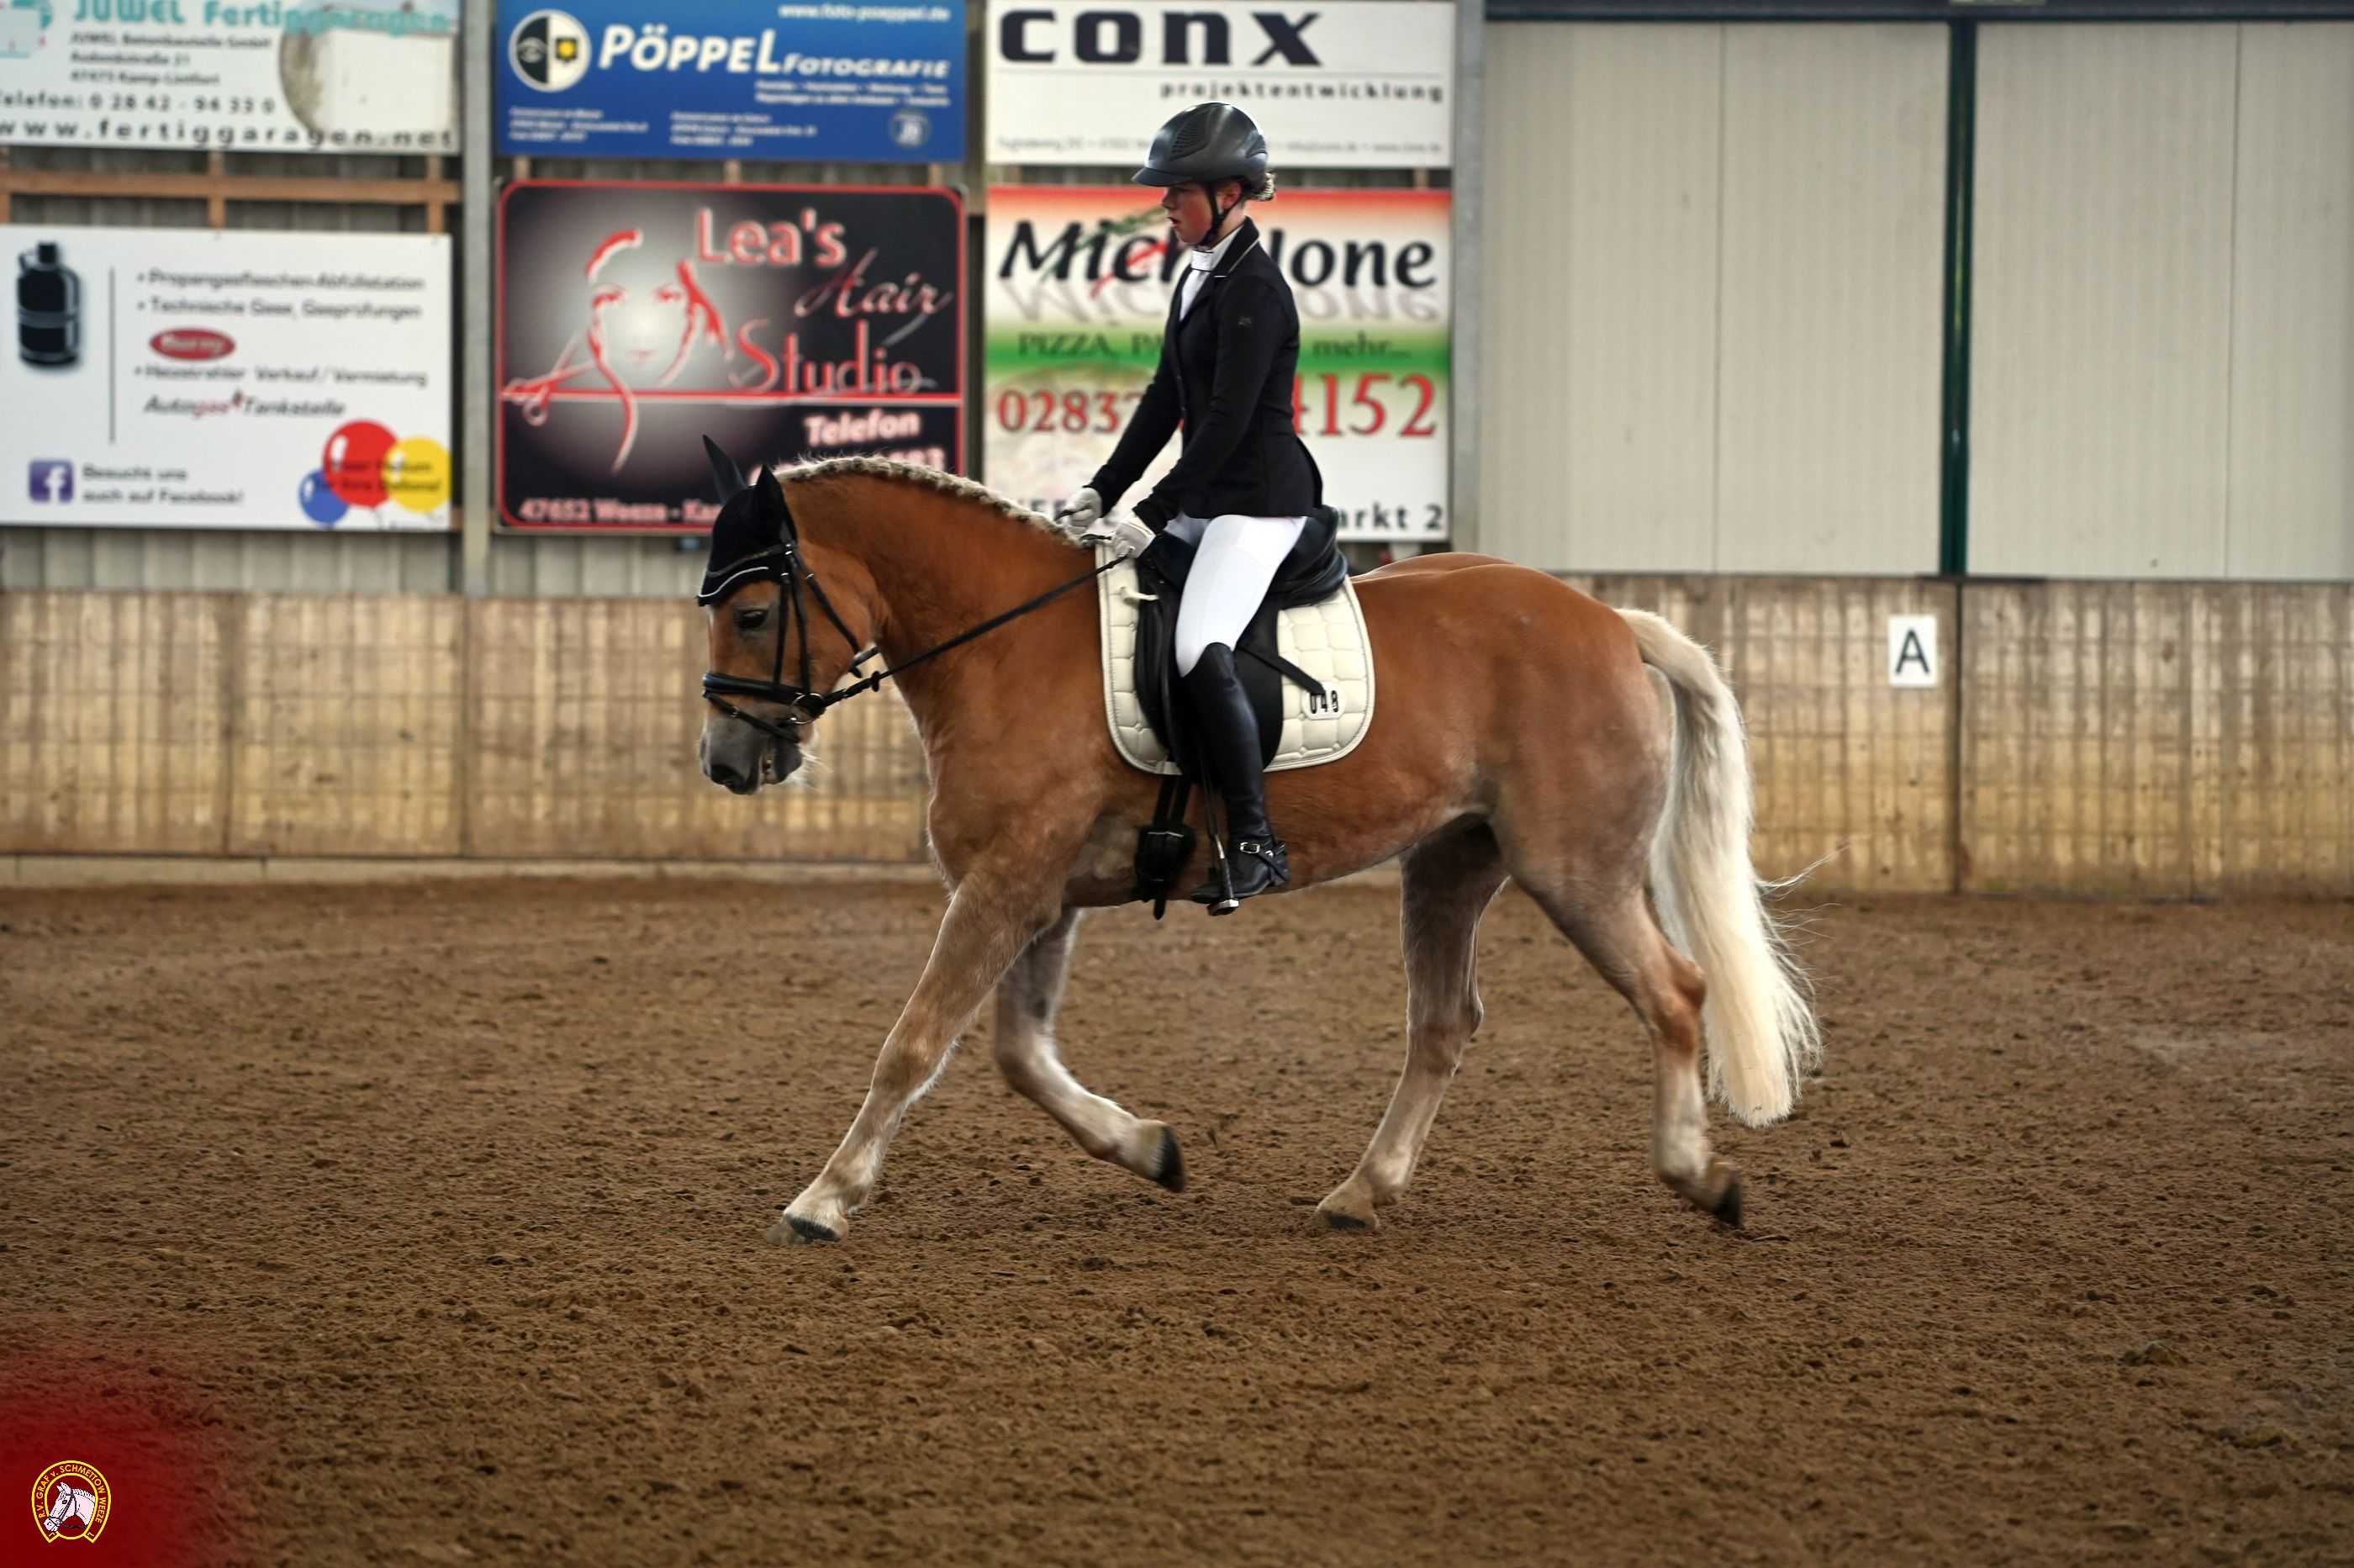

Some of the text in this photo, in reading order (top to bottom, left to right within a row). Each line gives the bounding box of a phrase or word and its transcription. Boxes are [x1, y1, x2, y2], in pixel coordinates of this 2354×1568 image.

[598, 24, 950, 78] PÖPPEL FOTOGRAFIE
[1000, 10, 1322, 66] conx
[1161, 83, 1444, 103] projektentwicklung
[695, 207, 848, 267] Lea's
[793, 248, 953, 326] Hair
[728, 319, 938, 394] Studio
[805, 409, 921, 446] Telefon
[1426, 503, 1443, 531] 2
[1895, 629, 1929, 675] A
